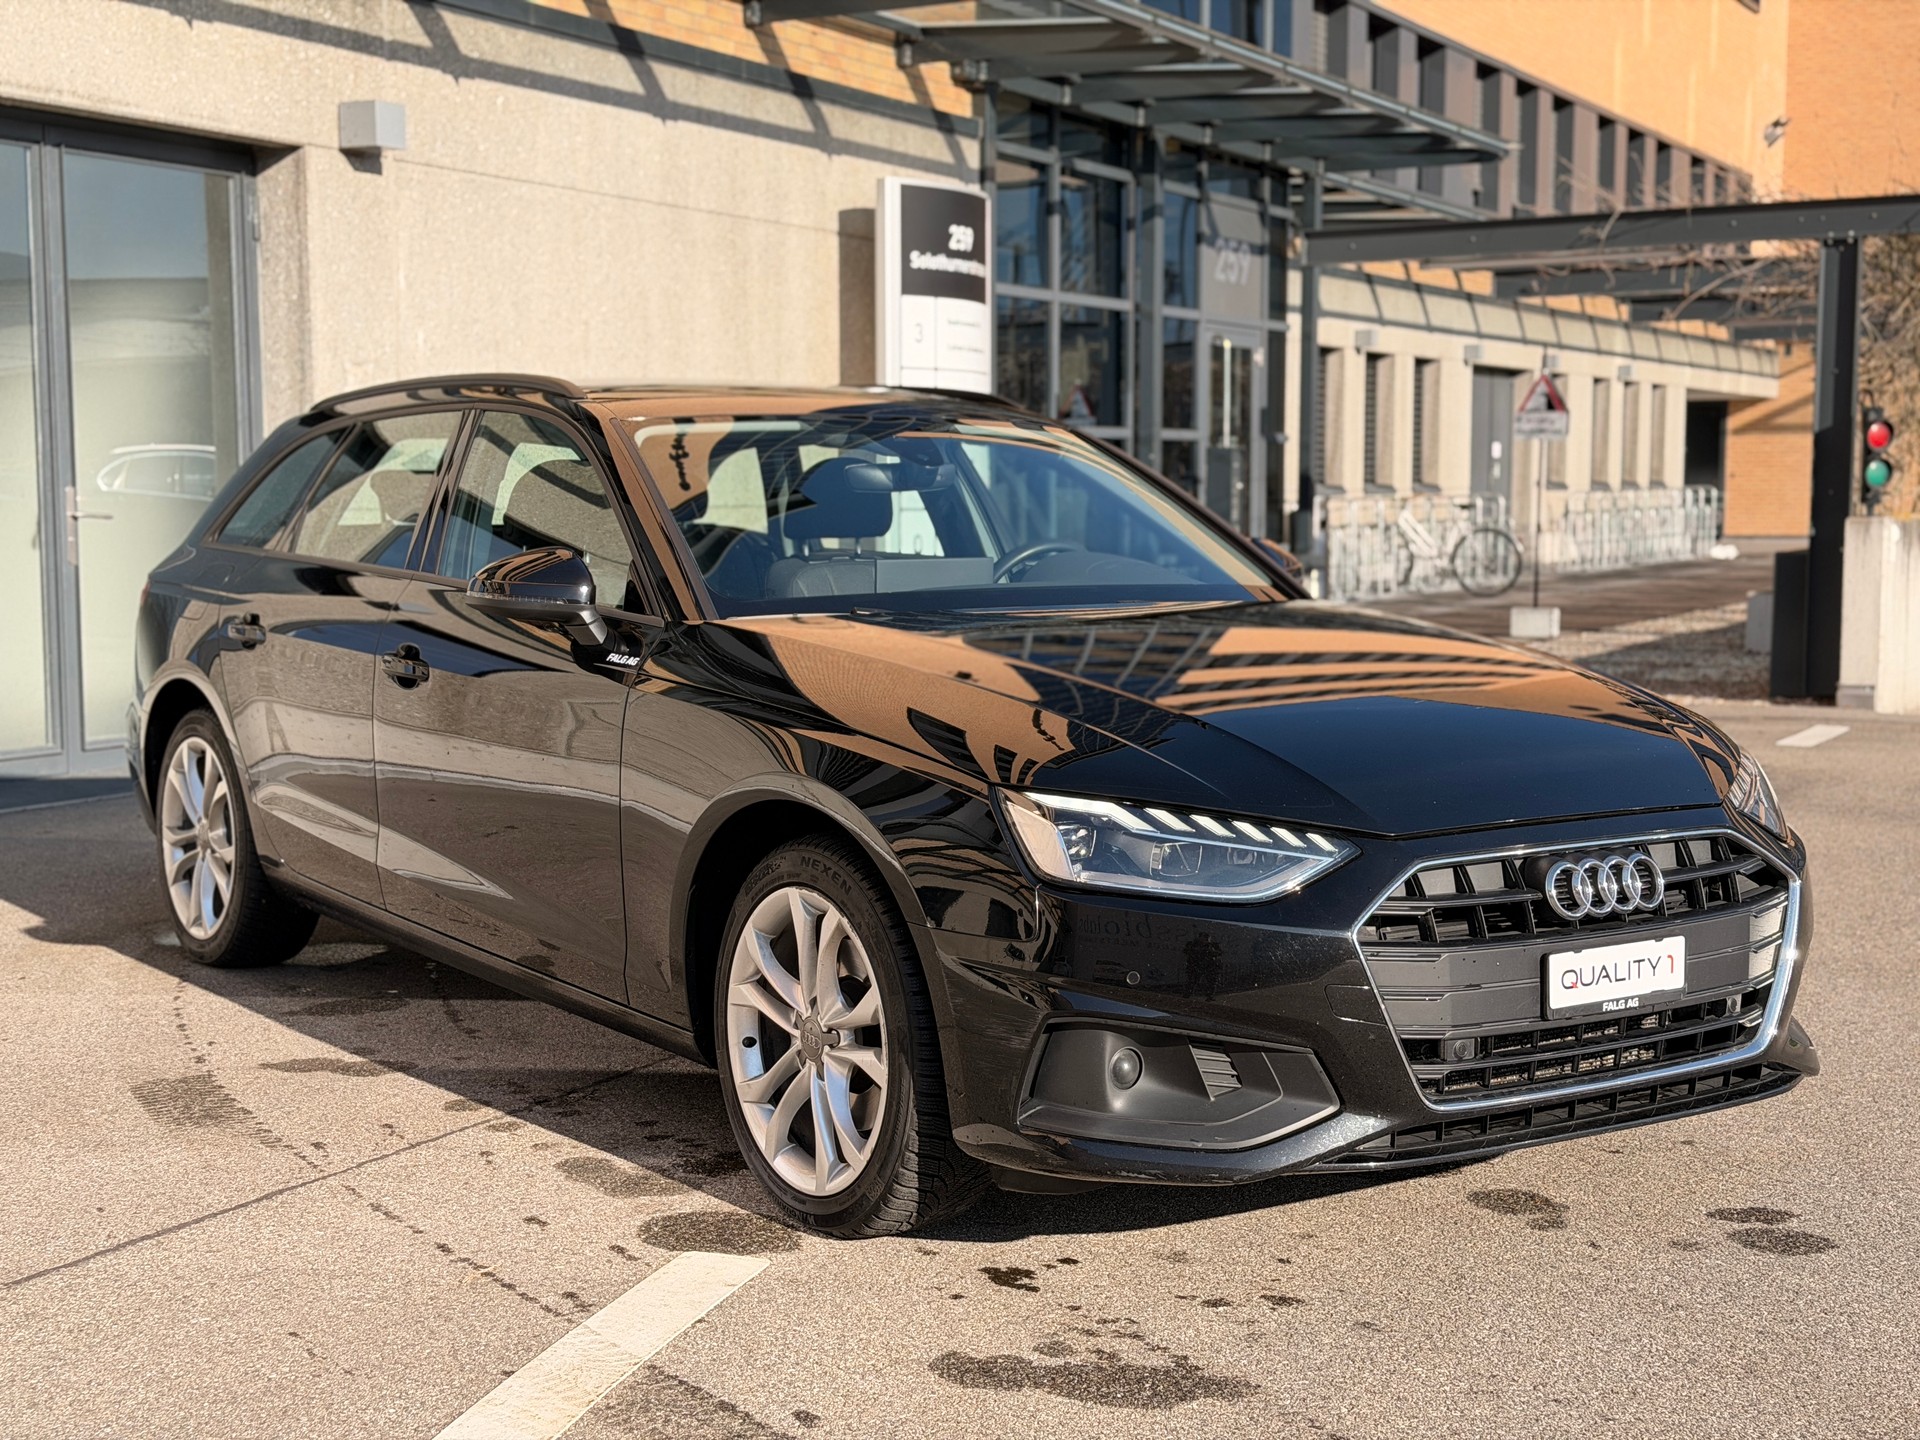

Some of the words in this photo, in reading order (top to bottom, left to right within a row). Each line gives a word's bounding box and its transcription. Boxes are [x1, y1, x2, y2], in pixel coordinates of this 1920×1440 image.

[606, 653, 627, 664] FALG
[626, 657, 640, 666] AG
[801, 855, 852, 896] NEXEN
[1561, 956, 1661, 989] QUALITY
[1603, 1000, 1625, 1012] FALG
[1626, 997, 1639, 1008] AG
